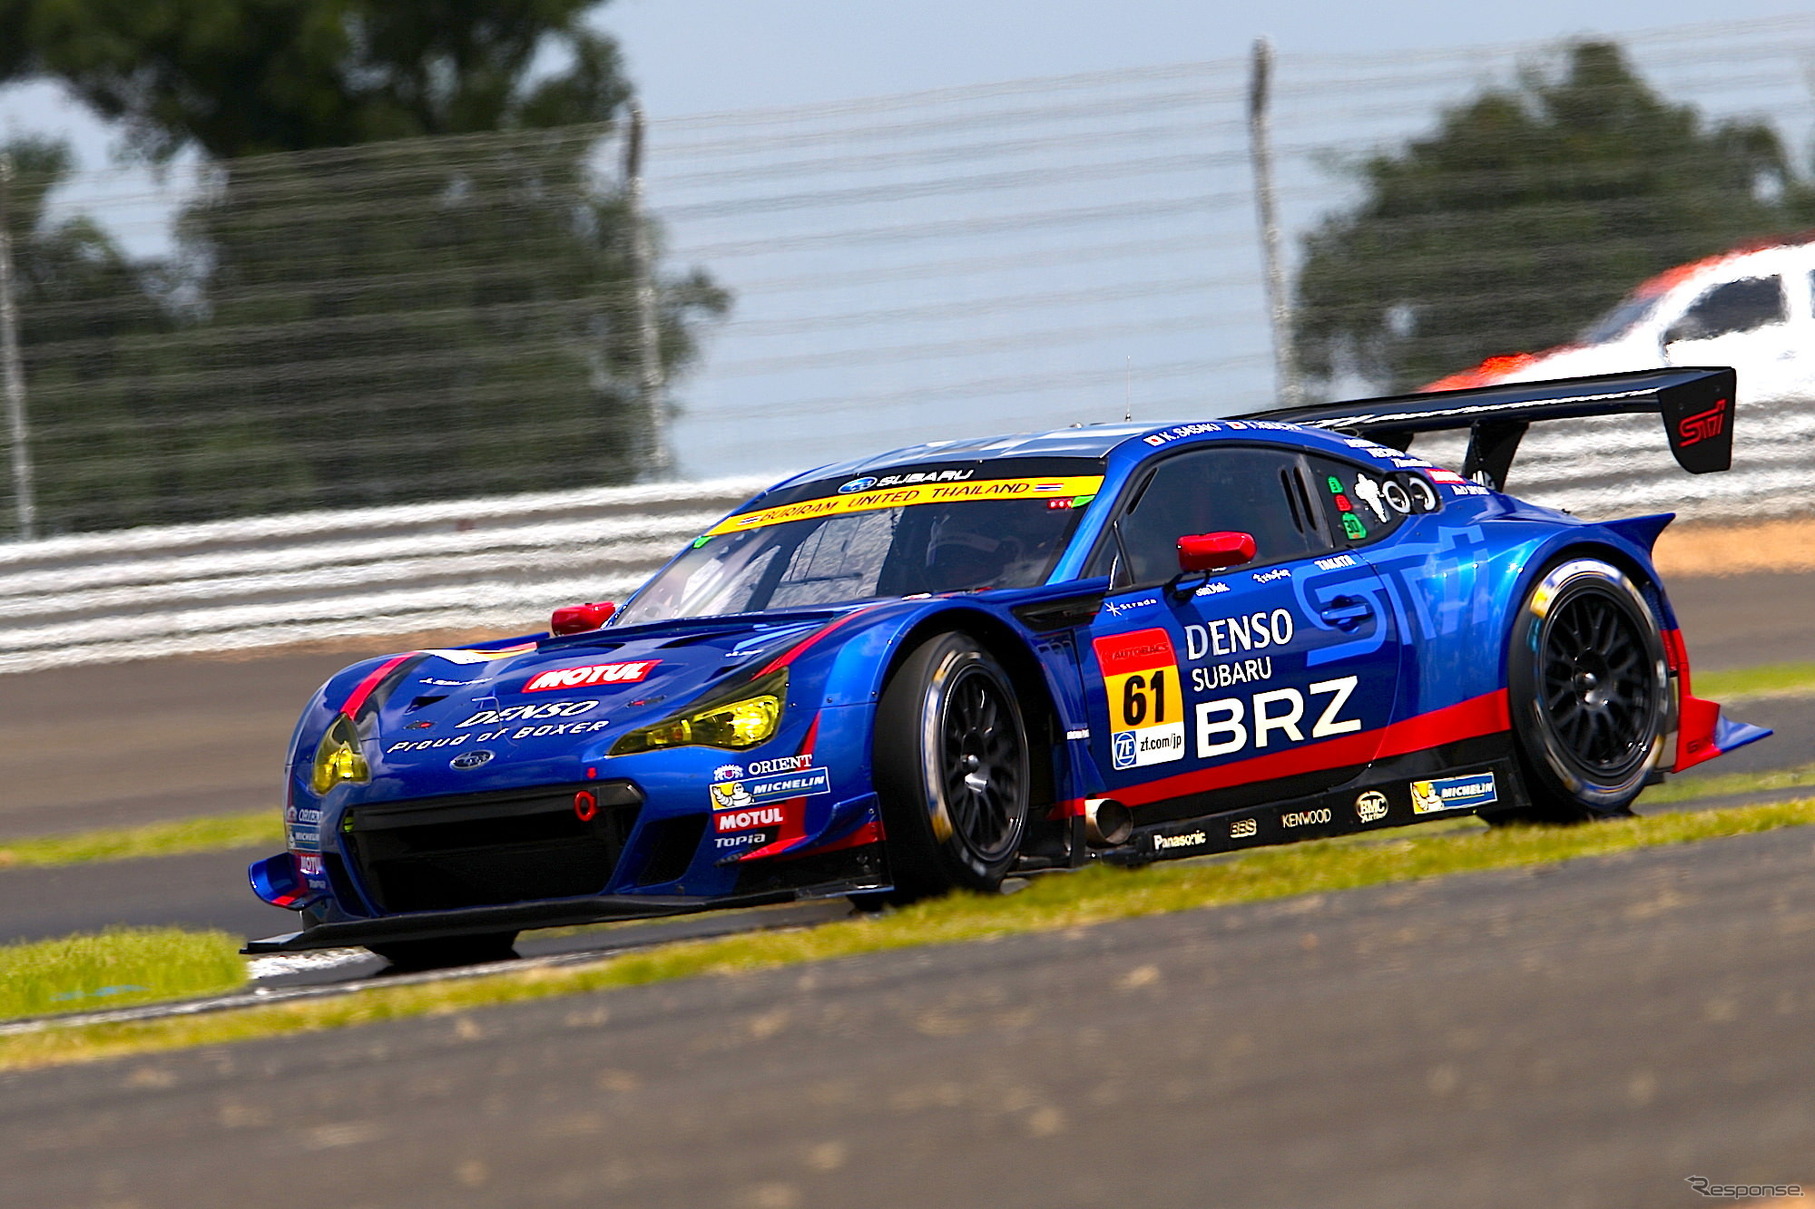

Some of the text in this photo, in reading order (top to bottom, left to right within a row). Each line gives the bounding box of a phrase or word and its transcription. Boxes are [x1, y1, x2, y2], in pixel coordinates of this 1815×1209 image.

[876, 469, 974, 487] SUBARU
[760, 482, 1030, 522] BURIRAM UNITED THAILAND
[1119, 598, 1157, 611] Strada
[1184, 608, 1294, 661] DENSO
[529, 662, 649, 690] MOTUL
[1191, 655, 1272, 693] SUBARU
[1122, 669, 1165, 727] 61
[455, 700, 600, 728] DENSO
[1195, 675, 1362, 759] BRZ
[386, 720, 610, 754] Proud of BOXER
[1139, 731, 1182, 753] zf.com/jp
[748, 753, 813, 776] ORIENT
[752, 775, 826, 795] MICHELIN
[1441, 782, 1494, 799] MICHELIN
[1283, 808, 1332, 829] KENWOOD
[1360, 799, 1386, 815] BMC
[719, 808, 784, 831] MOTUL
[1230, 818, 1257, 838] BBS
[1153, 829, 1206, 851] Panasonic
